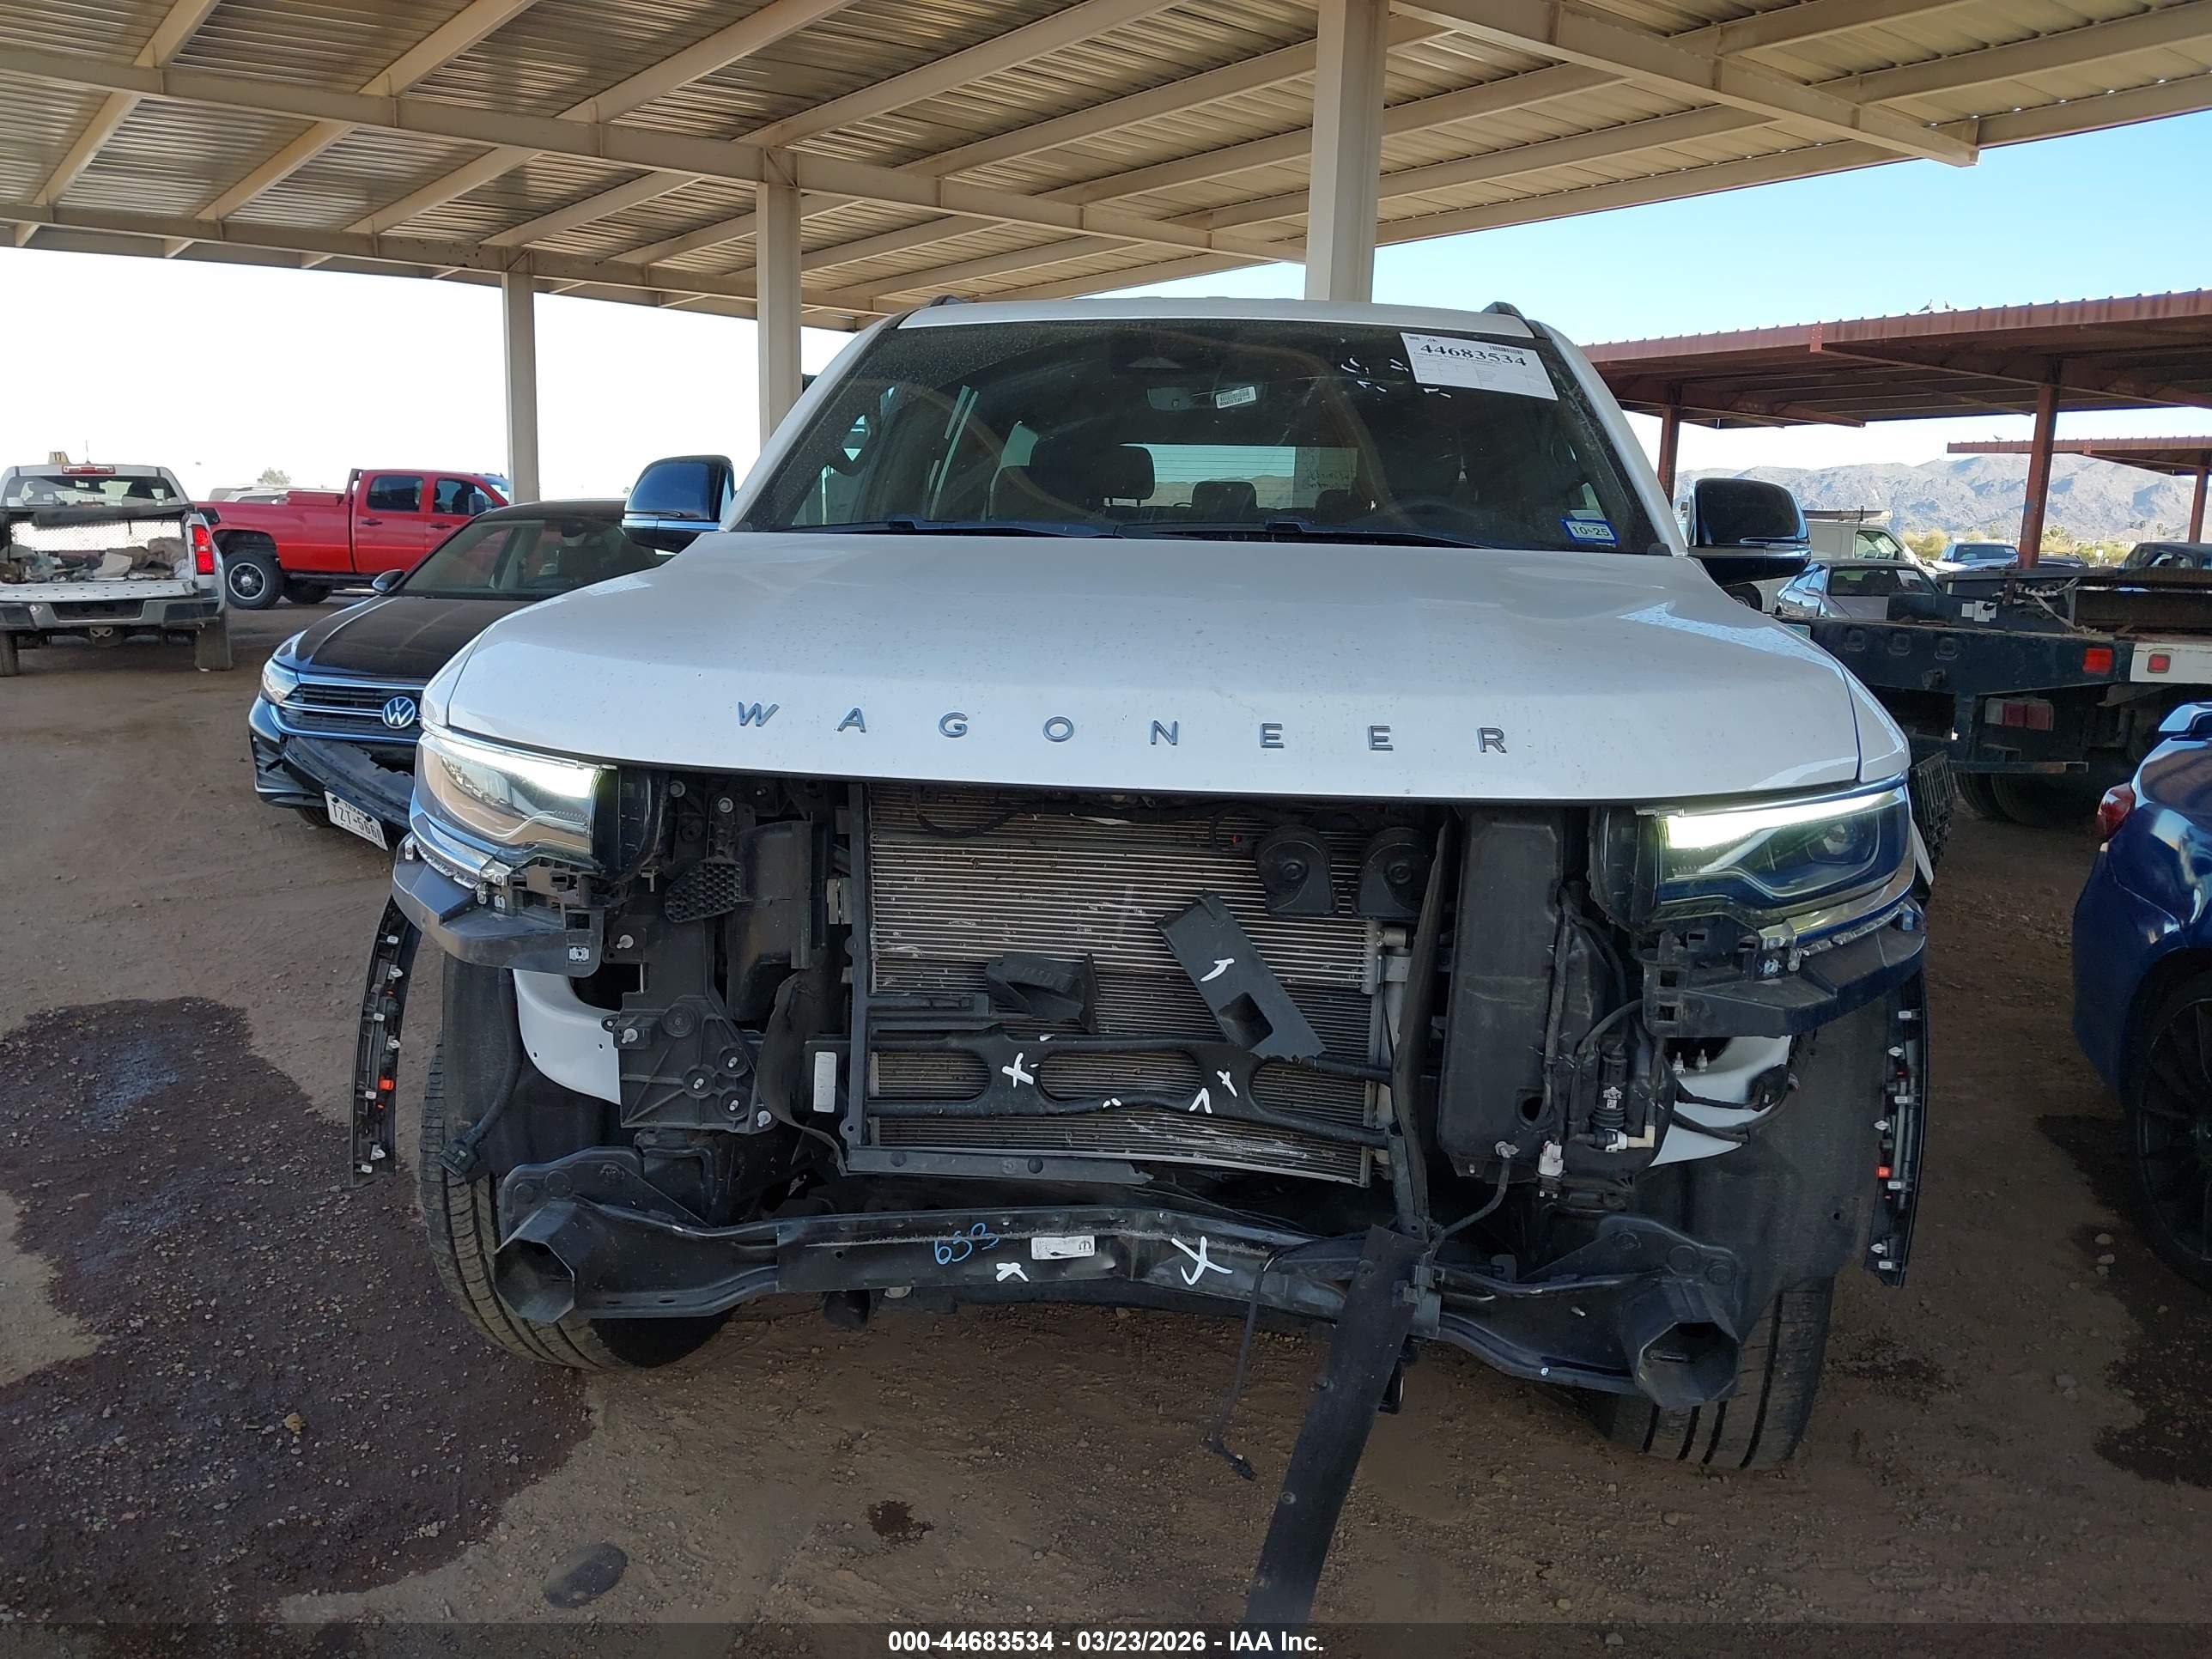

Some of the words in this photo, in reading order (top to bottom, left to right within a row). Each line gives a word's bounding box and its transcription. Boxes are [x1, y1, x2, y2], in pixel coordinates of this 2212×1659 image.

[1420, 344, 1528, 367] 44683534
[383, 696, 416, 729] VW
[738, 701, 1508, 754] WAGONEER
